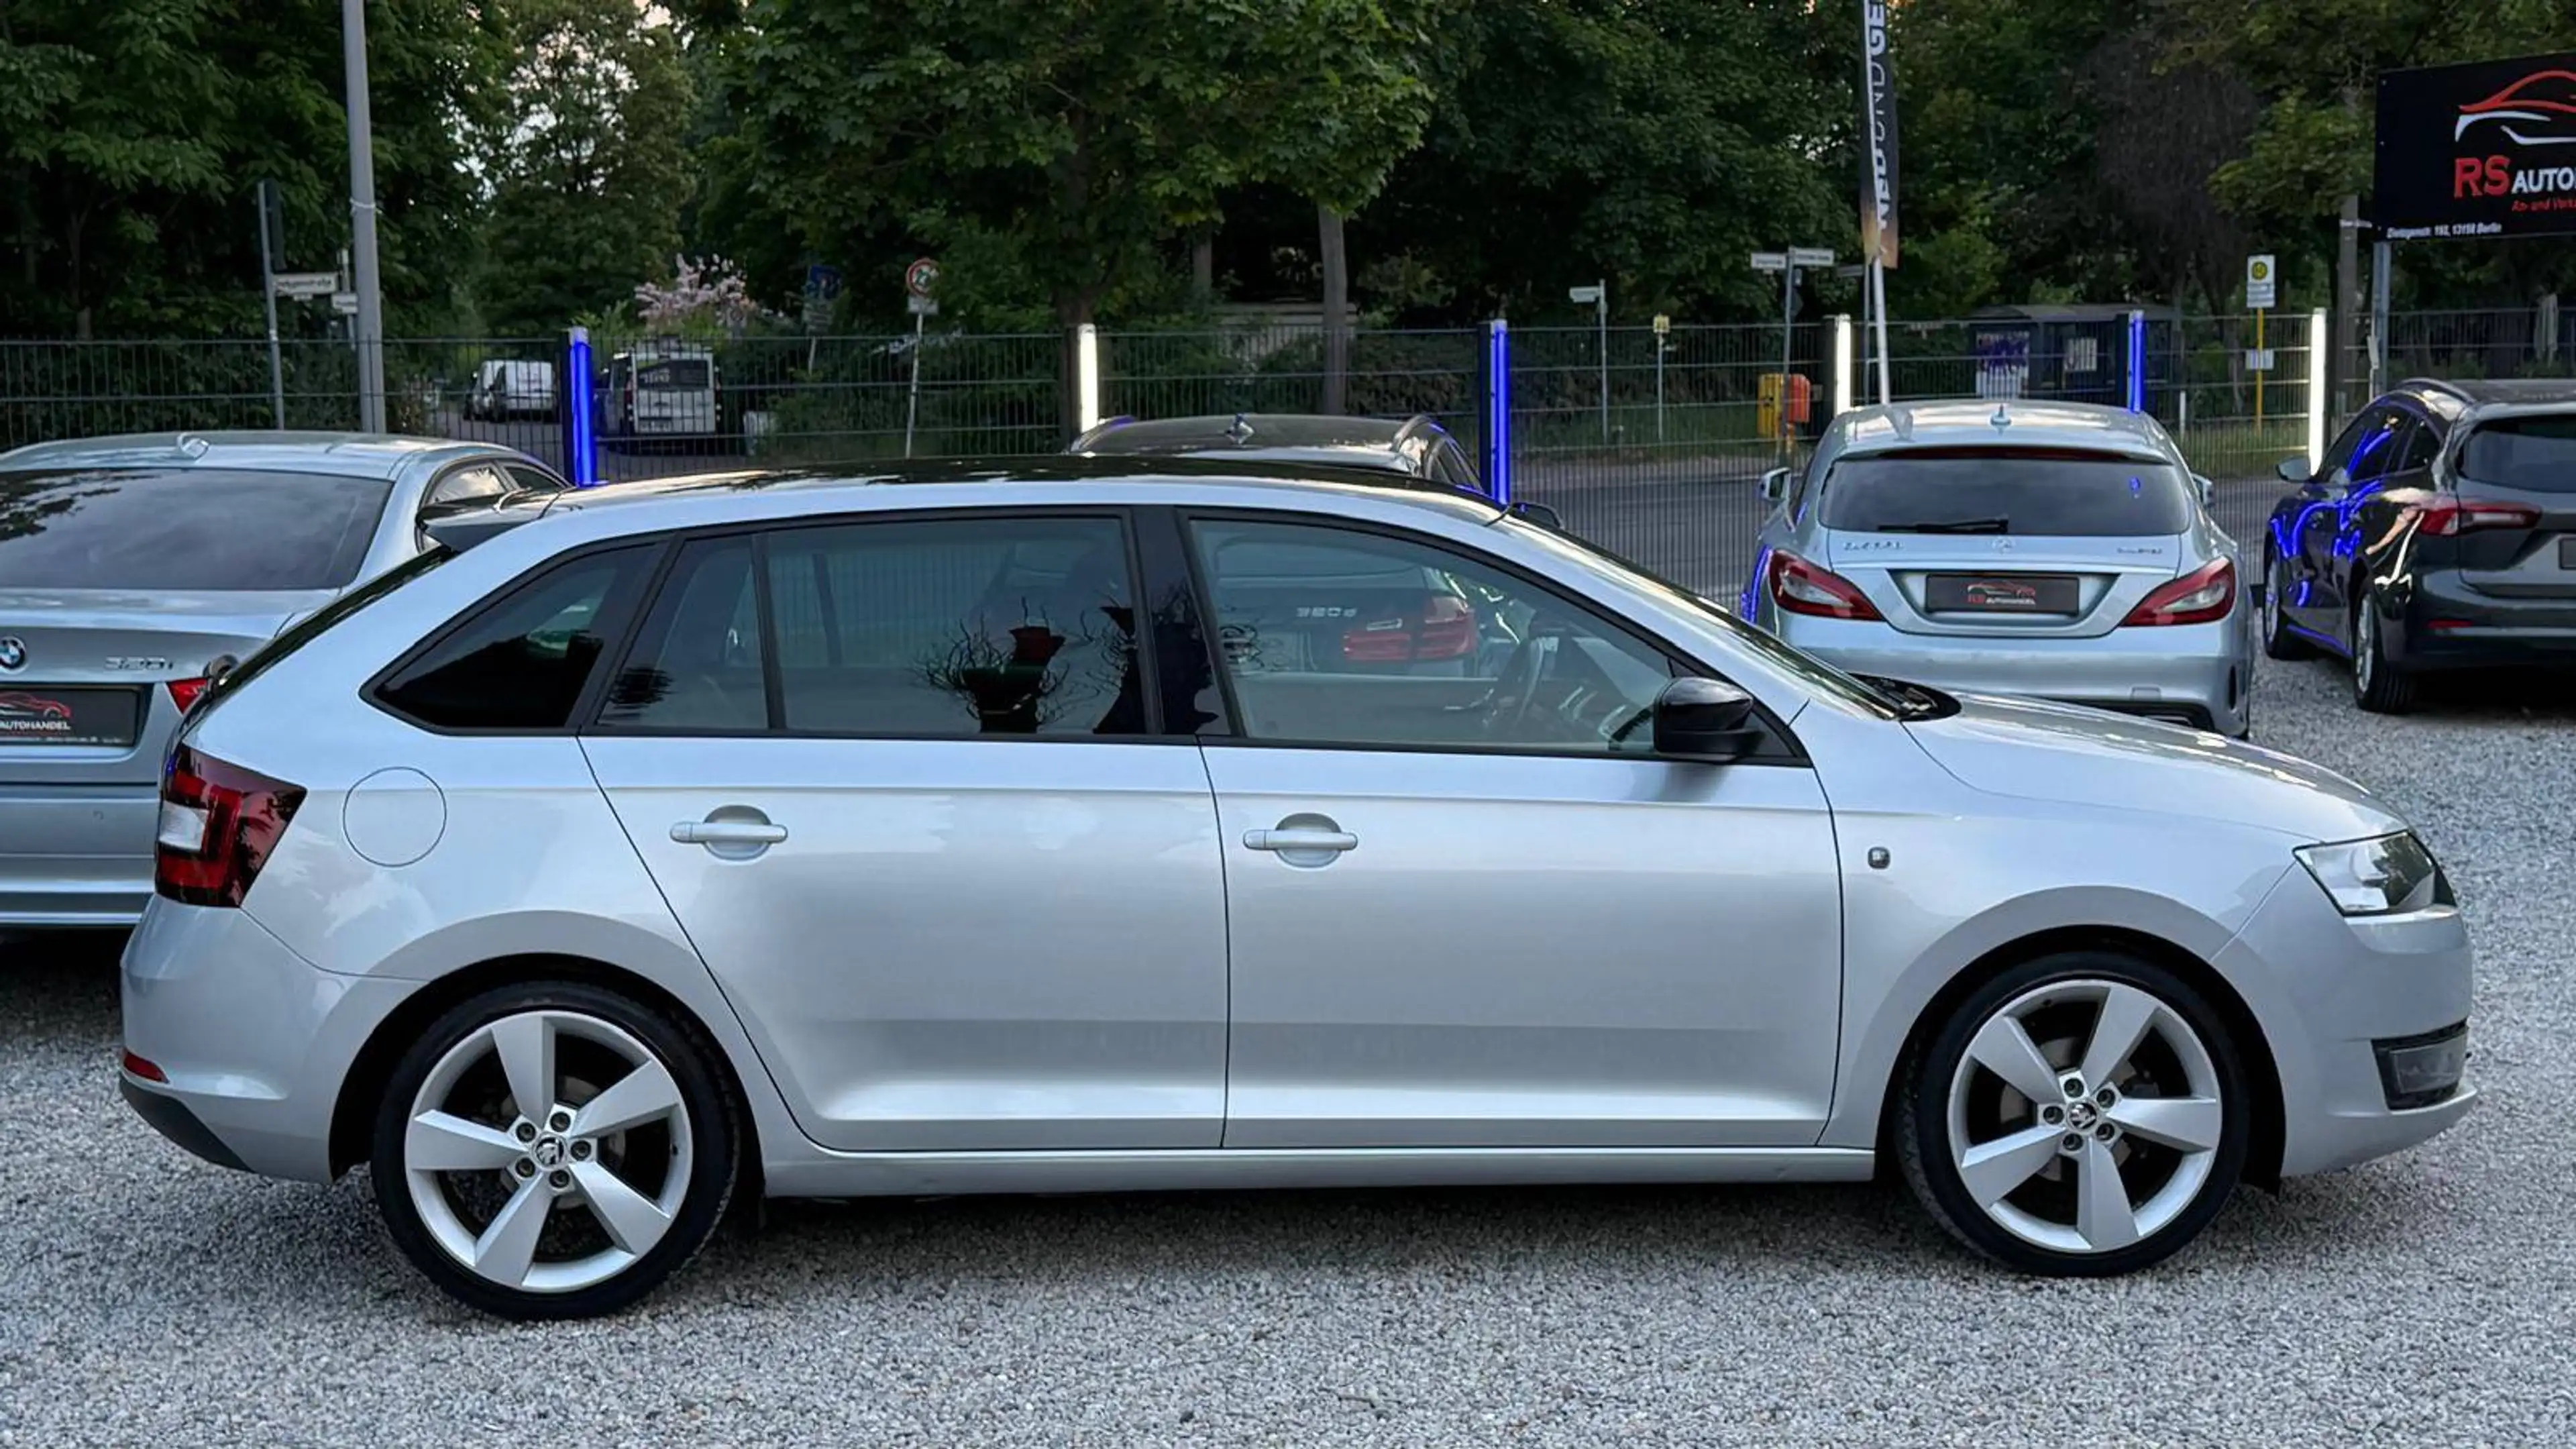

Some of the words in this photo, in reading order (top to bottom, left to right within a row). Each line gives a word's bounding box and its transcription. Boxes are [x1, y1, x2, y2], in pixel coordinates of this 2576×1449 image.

[2454, 155, 2510, 199] RS
[2511, 166, 2576, 194] AUTO
[104, 656, 173, 670] 320i
